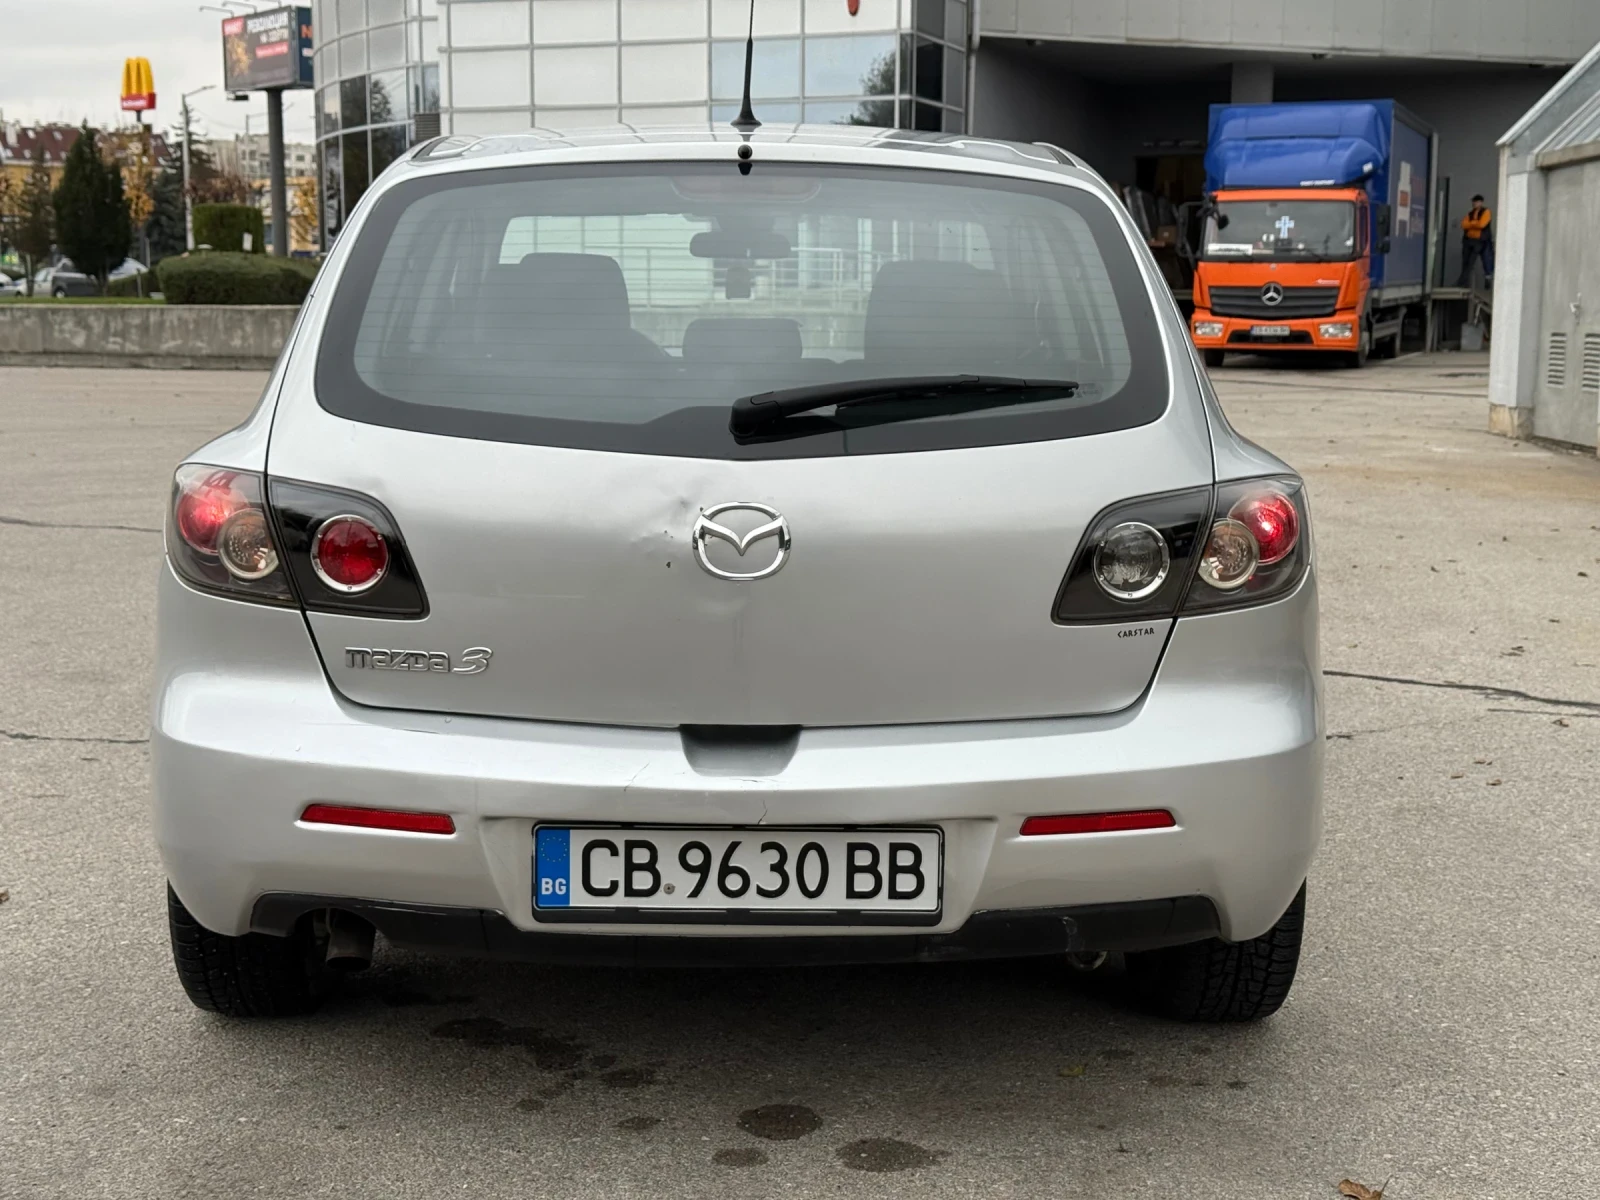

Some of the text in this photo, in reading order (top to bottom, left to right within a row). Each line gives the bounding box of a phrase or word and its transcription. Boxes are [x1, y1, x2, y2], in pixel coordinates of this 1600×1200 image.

[1117, 627, 1155, 638] CARSTAR
[451, 646, 494, 675] 3
[581, 838, 926, 900] CB 9630 BB
[541, 877, 567, 895] BG
